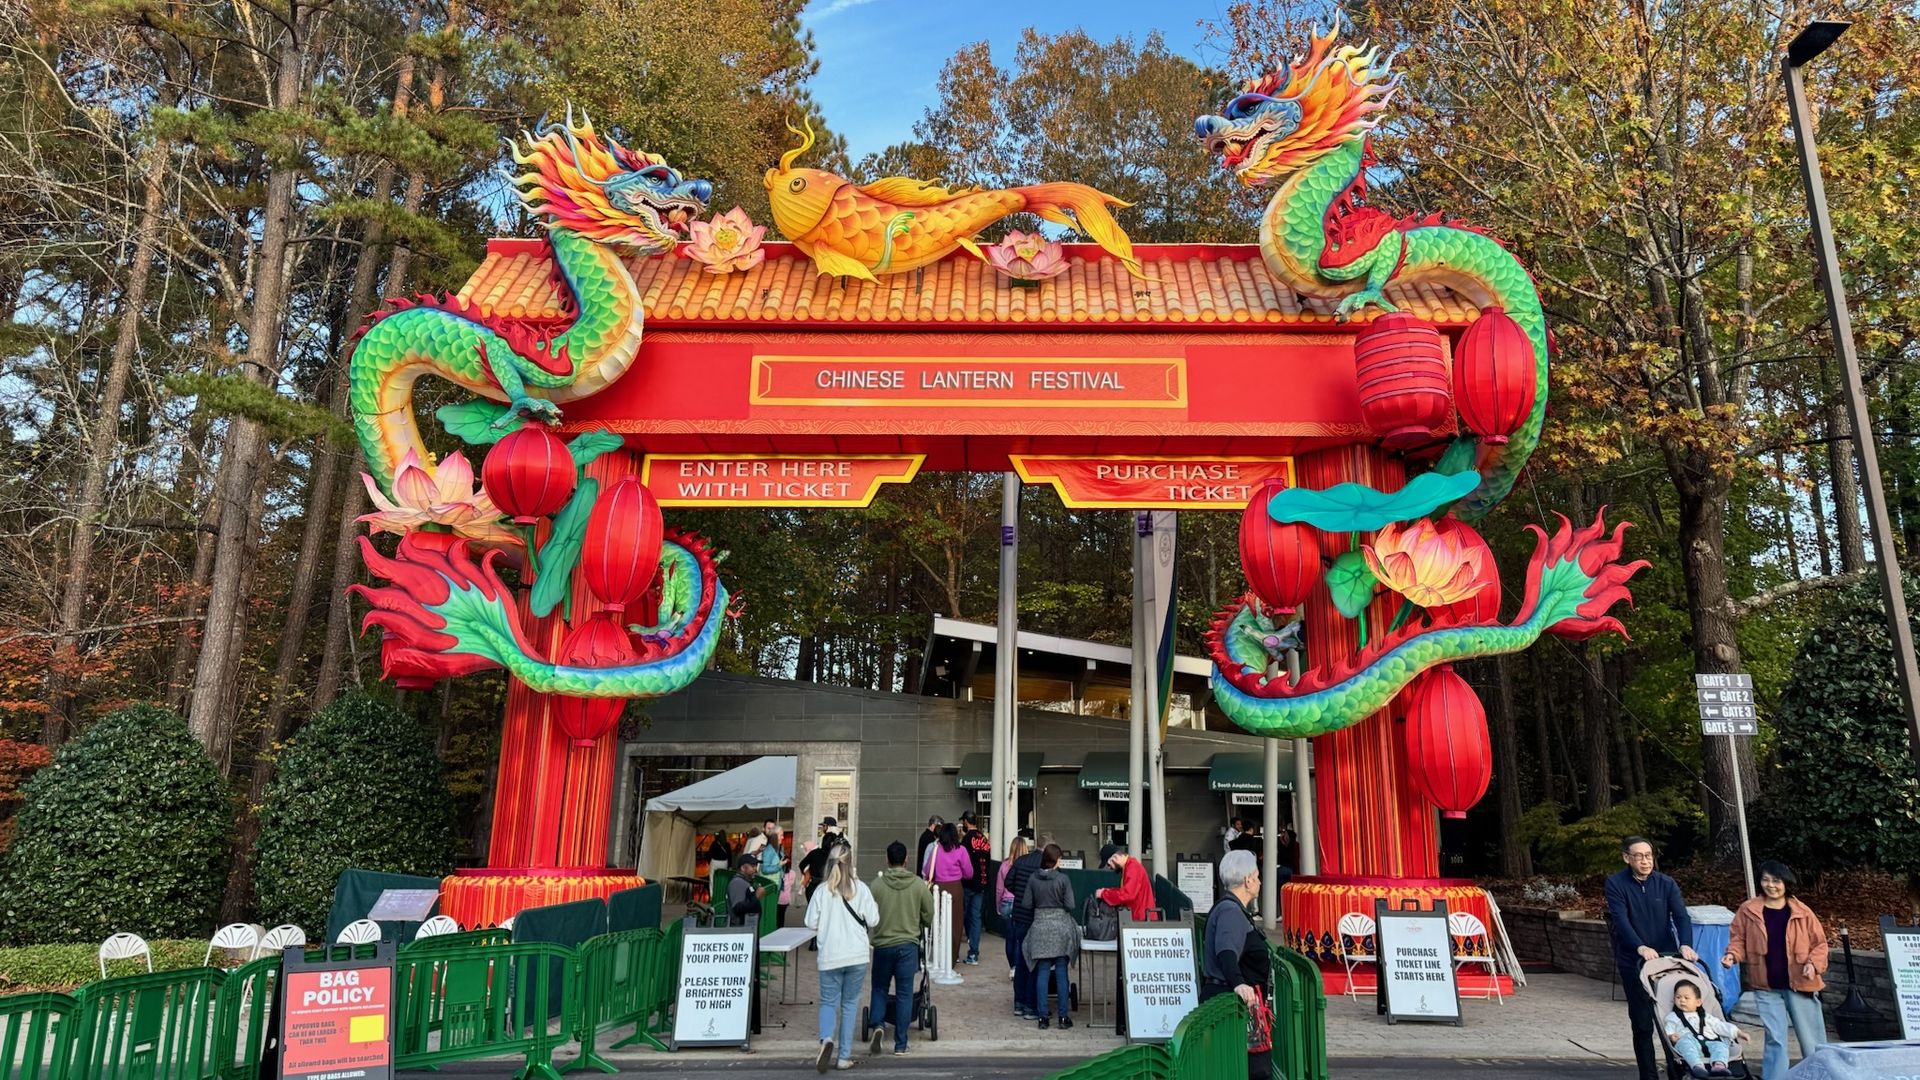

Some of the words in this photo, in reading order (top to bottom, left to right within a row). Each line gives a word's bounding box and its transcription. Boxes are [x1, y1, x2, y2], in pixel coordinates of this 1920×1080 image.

[816, 370, 905, 389] CHINESE
[921, 370, 1014, 389] LANTERN
[1030, 370, 1125, 390] FESTIVAL
[679, 462, 769, 477] ENTER
[781, 462, 852, 477] HERE
[1097, 464, 1240, 480] PURCHASE
[677, 482, 749, 497] WITH
[759, 482, 852, 497] TICKET
[1167, 485, 1252, 500] TICKET
[1702, 675, 1725, 687] GATE
[1725, 675, 1731, 687] 1
[1720, 690, 1742, 702] GATE
[1742, 690, 1750, 702] 2
[1722, 706, 1744, 718] GATE
[1744, 706, 1752, 718] 3
[1705, 722, 1727, 733] GATE
[1727, 722, 1735, 733] 5
[692, 942, 729, 952] TICKETS
[731, 942, 744, 952] ON
[1131, 937, 1169, 947] TICKETS
[1171, 937, 1184, 947] ON
[1127, 949, 1152, 959] YOUR
[1154, 949, 1190, 959] PHONE?
[1396, 947, 1438, 957] PURCHASE
[686, 954, 710, 964] YOUR
[712, 953, 749, 963] PHONE?
[1396, 960, 1423, 969] TICKET
[1424, 960, 1441, 969] LINE
[320, 971, 359, 987] BAG
[684, 977, 719, 987] PLEASE
[721, 976, 746, 986] TURN
[1130, 972, 1165, 982] PLEASE
[1166, 972, 1192, 982] TURN
[1394, 971, 1425, 981] STARTS
[1426, 972, 1446, 981] HERE
[685, 988, 743, 998] BRIGHTNESS
[1133, 984, 1191, 994] BRIGHTNESS
[303, 987, 374, 1006] POLICY
[1144, 996, 1156, 1006] TO
[1159, 996, 1182, 1006] HIGH
[695, 1000, 707, 1010] TO
[709, 1000, 732, 1009] HIGH
[288, 1061, 297, 1069] All
[297, 1060, 321, 1068] allowed
[357, 1053, 384, 1063] searched
[341, 1070, 366, 1078] ALLOWED:
